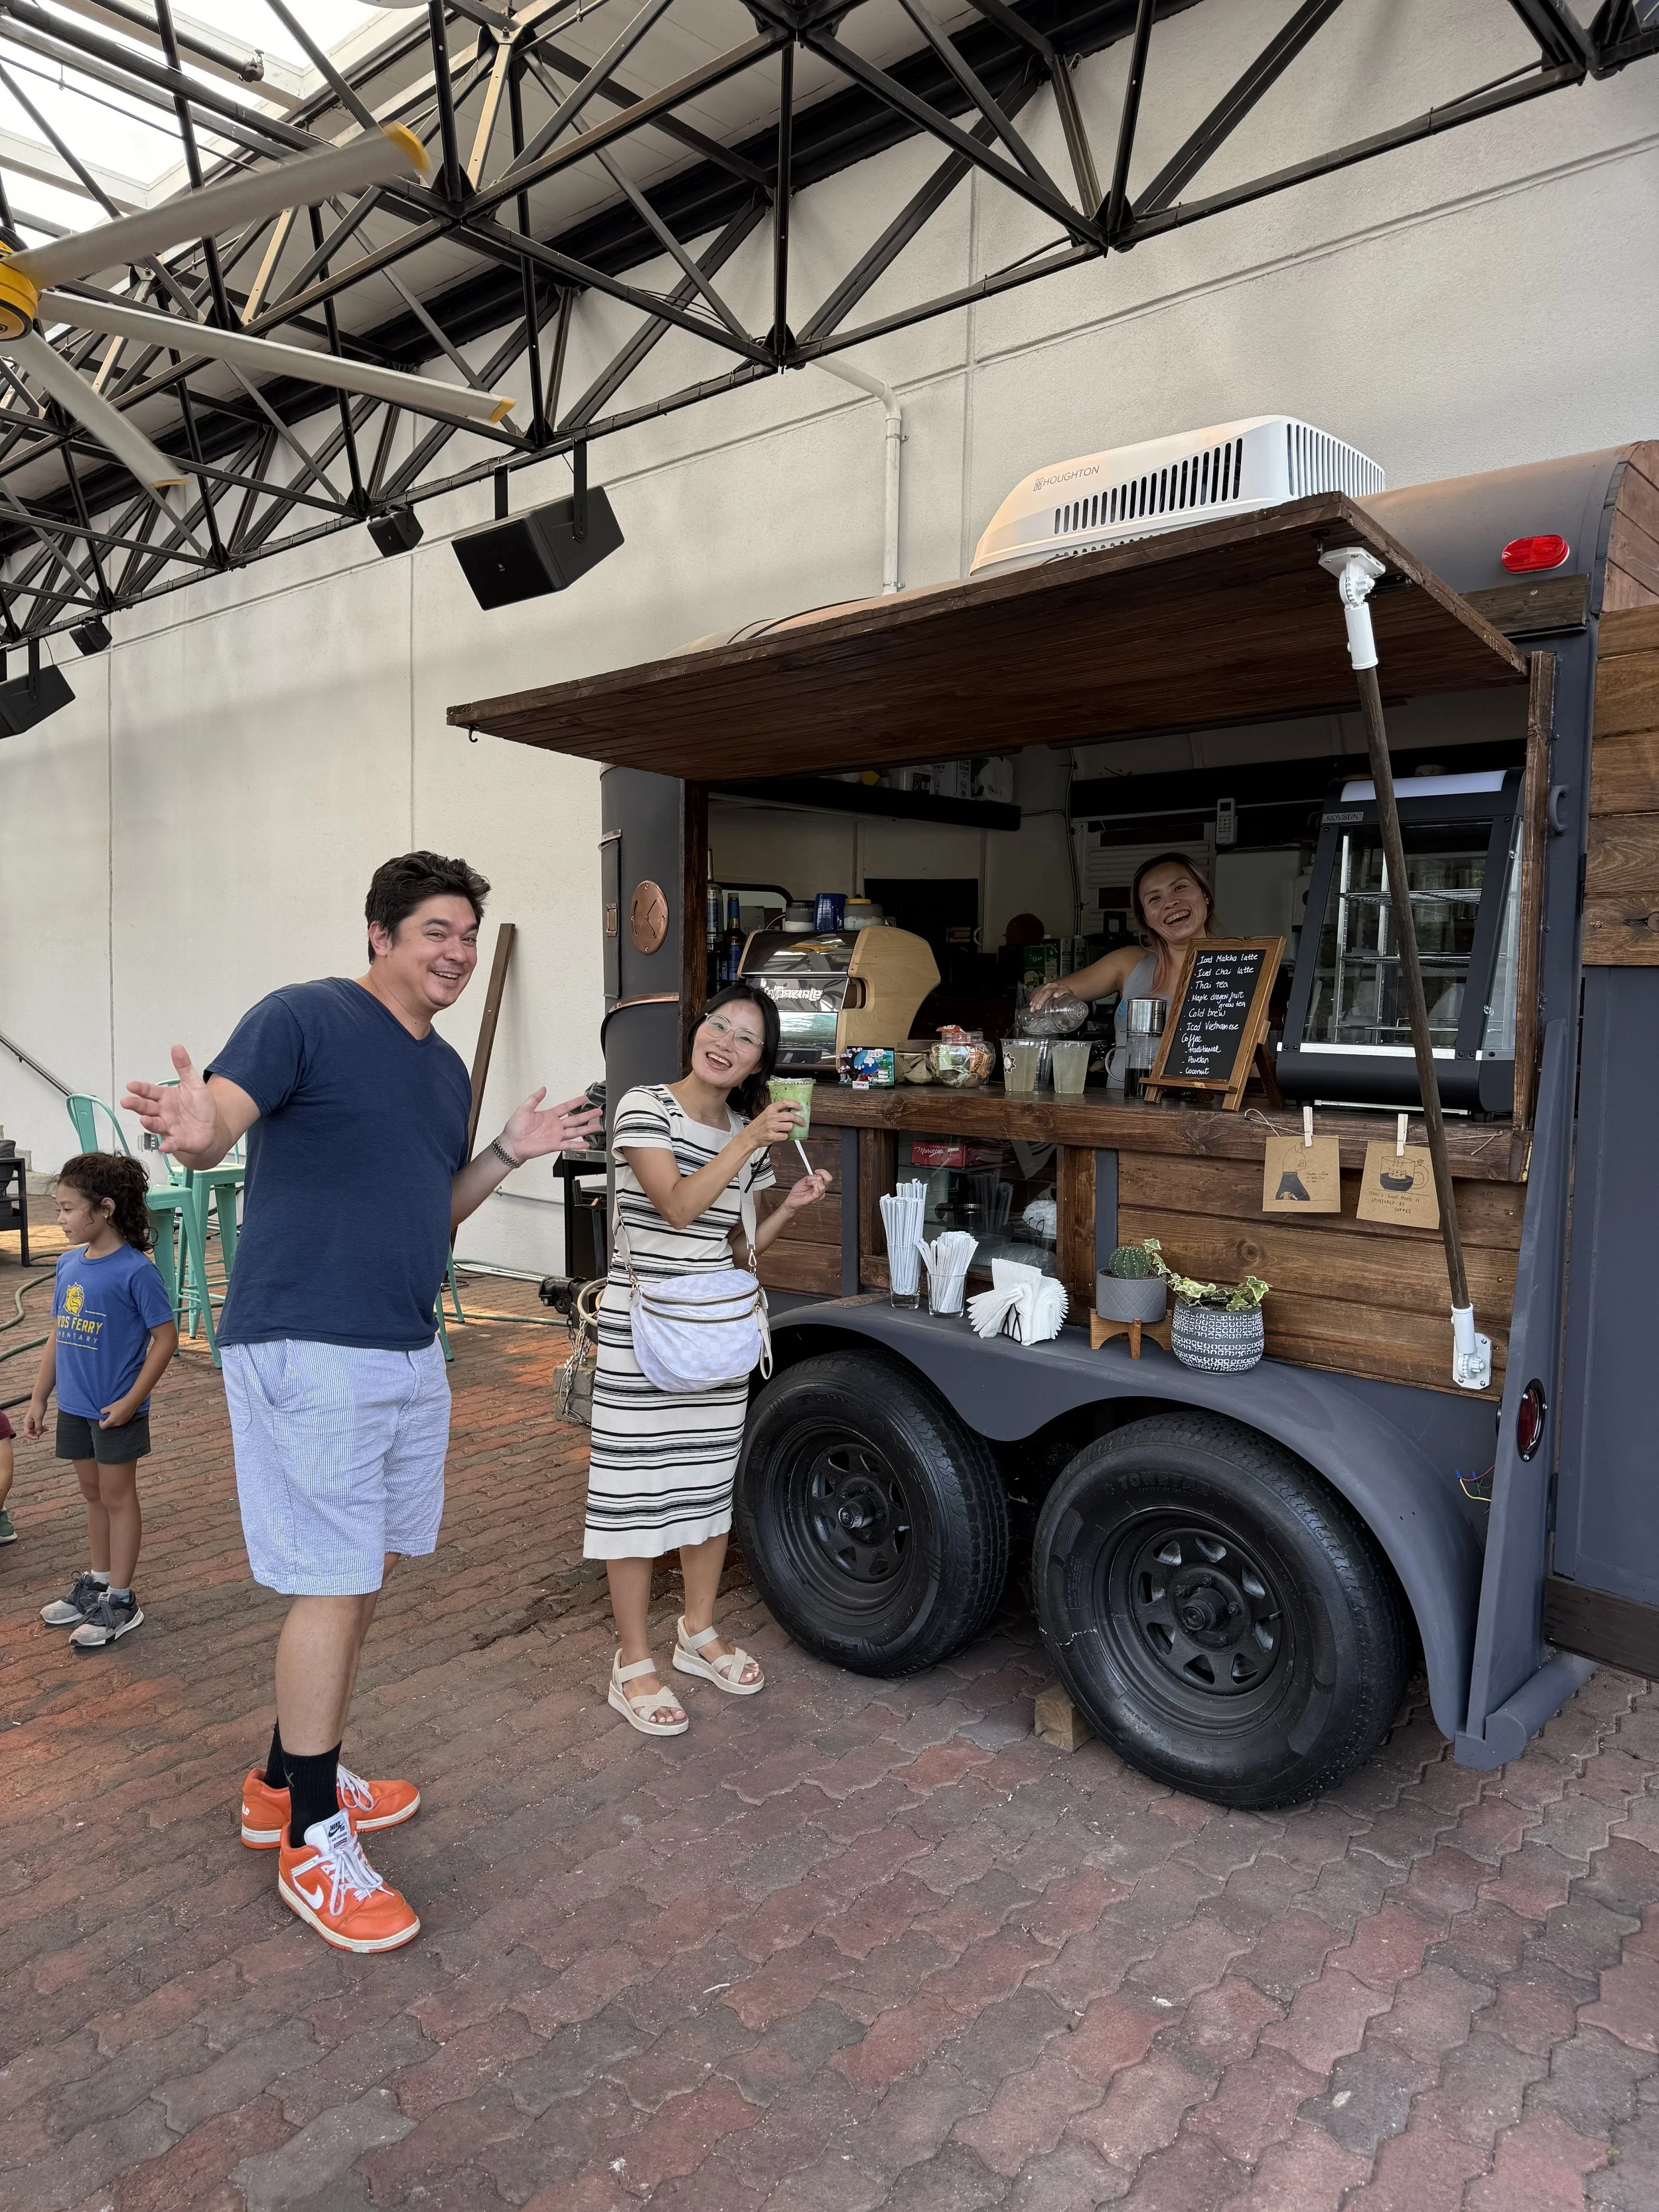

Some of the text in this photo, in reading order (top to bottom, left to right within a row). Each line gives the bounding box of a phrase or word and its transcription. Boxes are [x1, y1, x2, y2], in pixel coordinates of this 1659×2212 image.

[1043, 465, 1100, 486] HOUGHTON
[1327, 812, 1358, 822] ROVSUN
[1198, 956, 1213, 964] Iced
[1196, 968, 1212, 978] Iced
[1237, 966, 1254, 974] latte
[1195, 980, 1212, 990] Thai
[1191, 994, 1208, 1003] Maple
[1189, 1007, 1226, 1018] Cold brew
[1187, 1020, 1240, 1031] Iced Vietnamese
[1188, 1045, 1222, 1053] traditional
[71, 1317, 104, 1335] FERRY
[1118, 1470, 1212, 1497] TOWSTAR
[330, 1820, 341, 1832] NIKE
